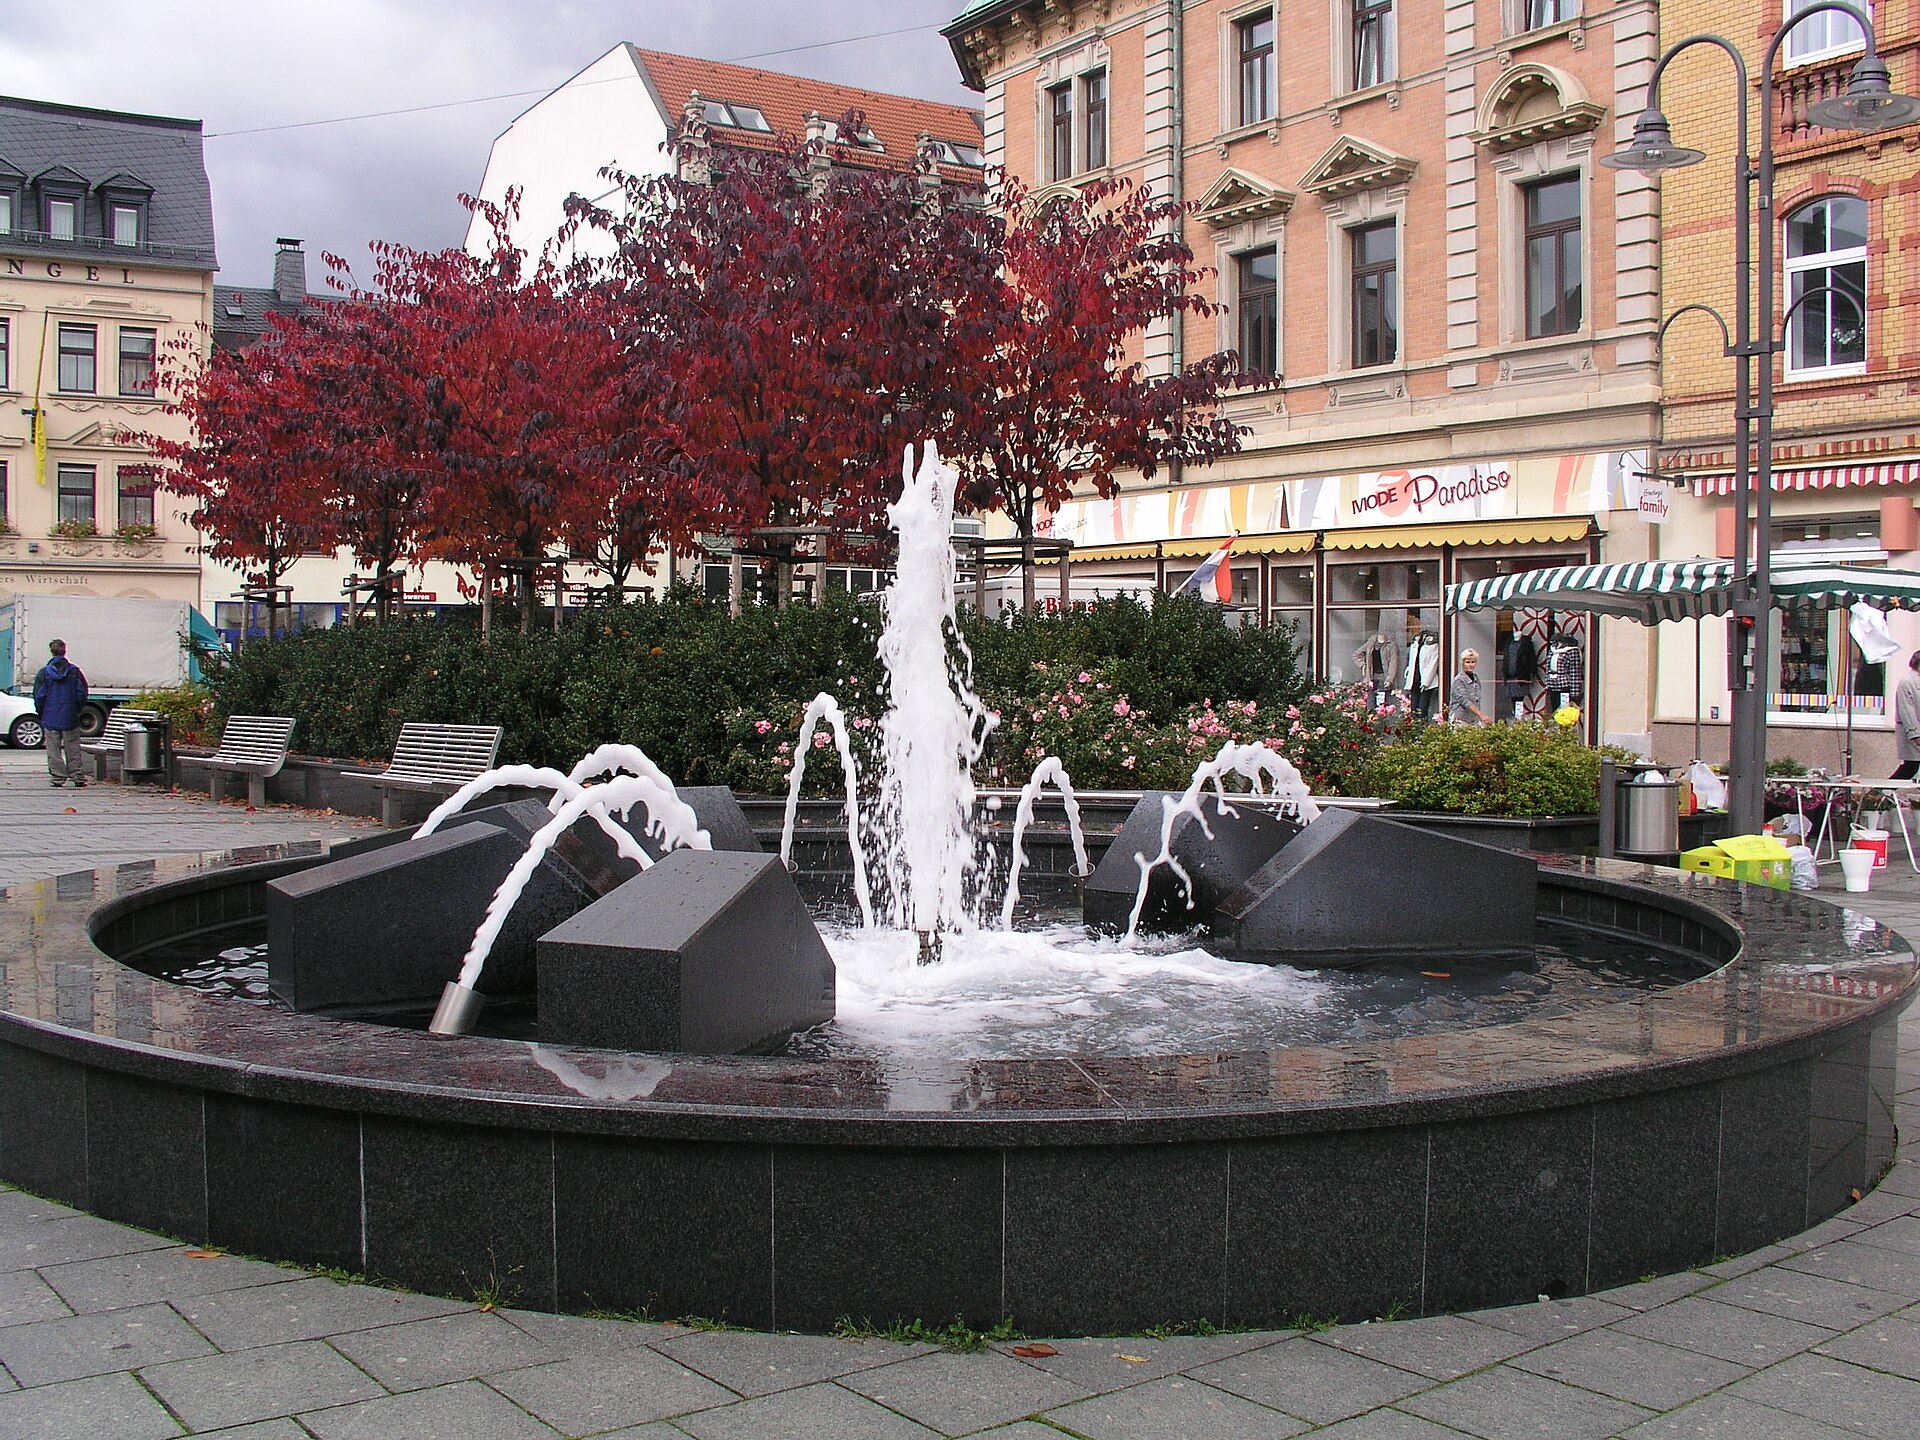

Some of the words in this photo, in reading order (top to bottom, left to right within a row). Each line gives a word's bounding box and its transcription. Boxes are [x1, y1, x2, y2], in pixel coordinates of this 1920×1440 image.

[1351, 486, 1398, 515] MODE
[1403, 468, 1512, 514] Paradiso
[1639, 495, 1669, 518] family
[26, 574, 88, 584] Wirtschaft
